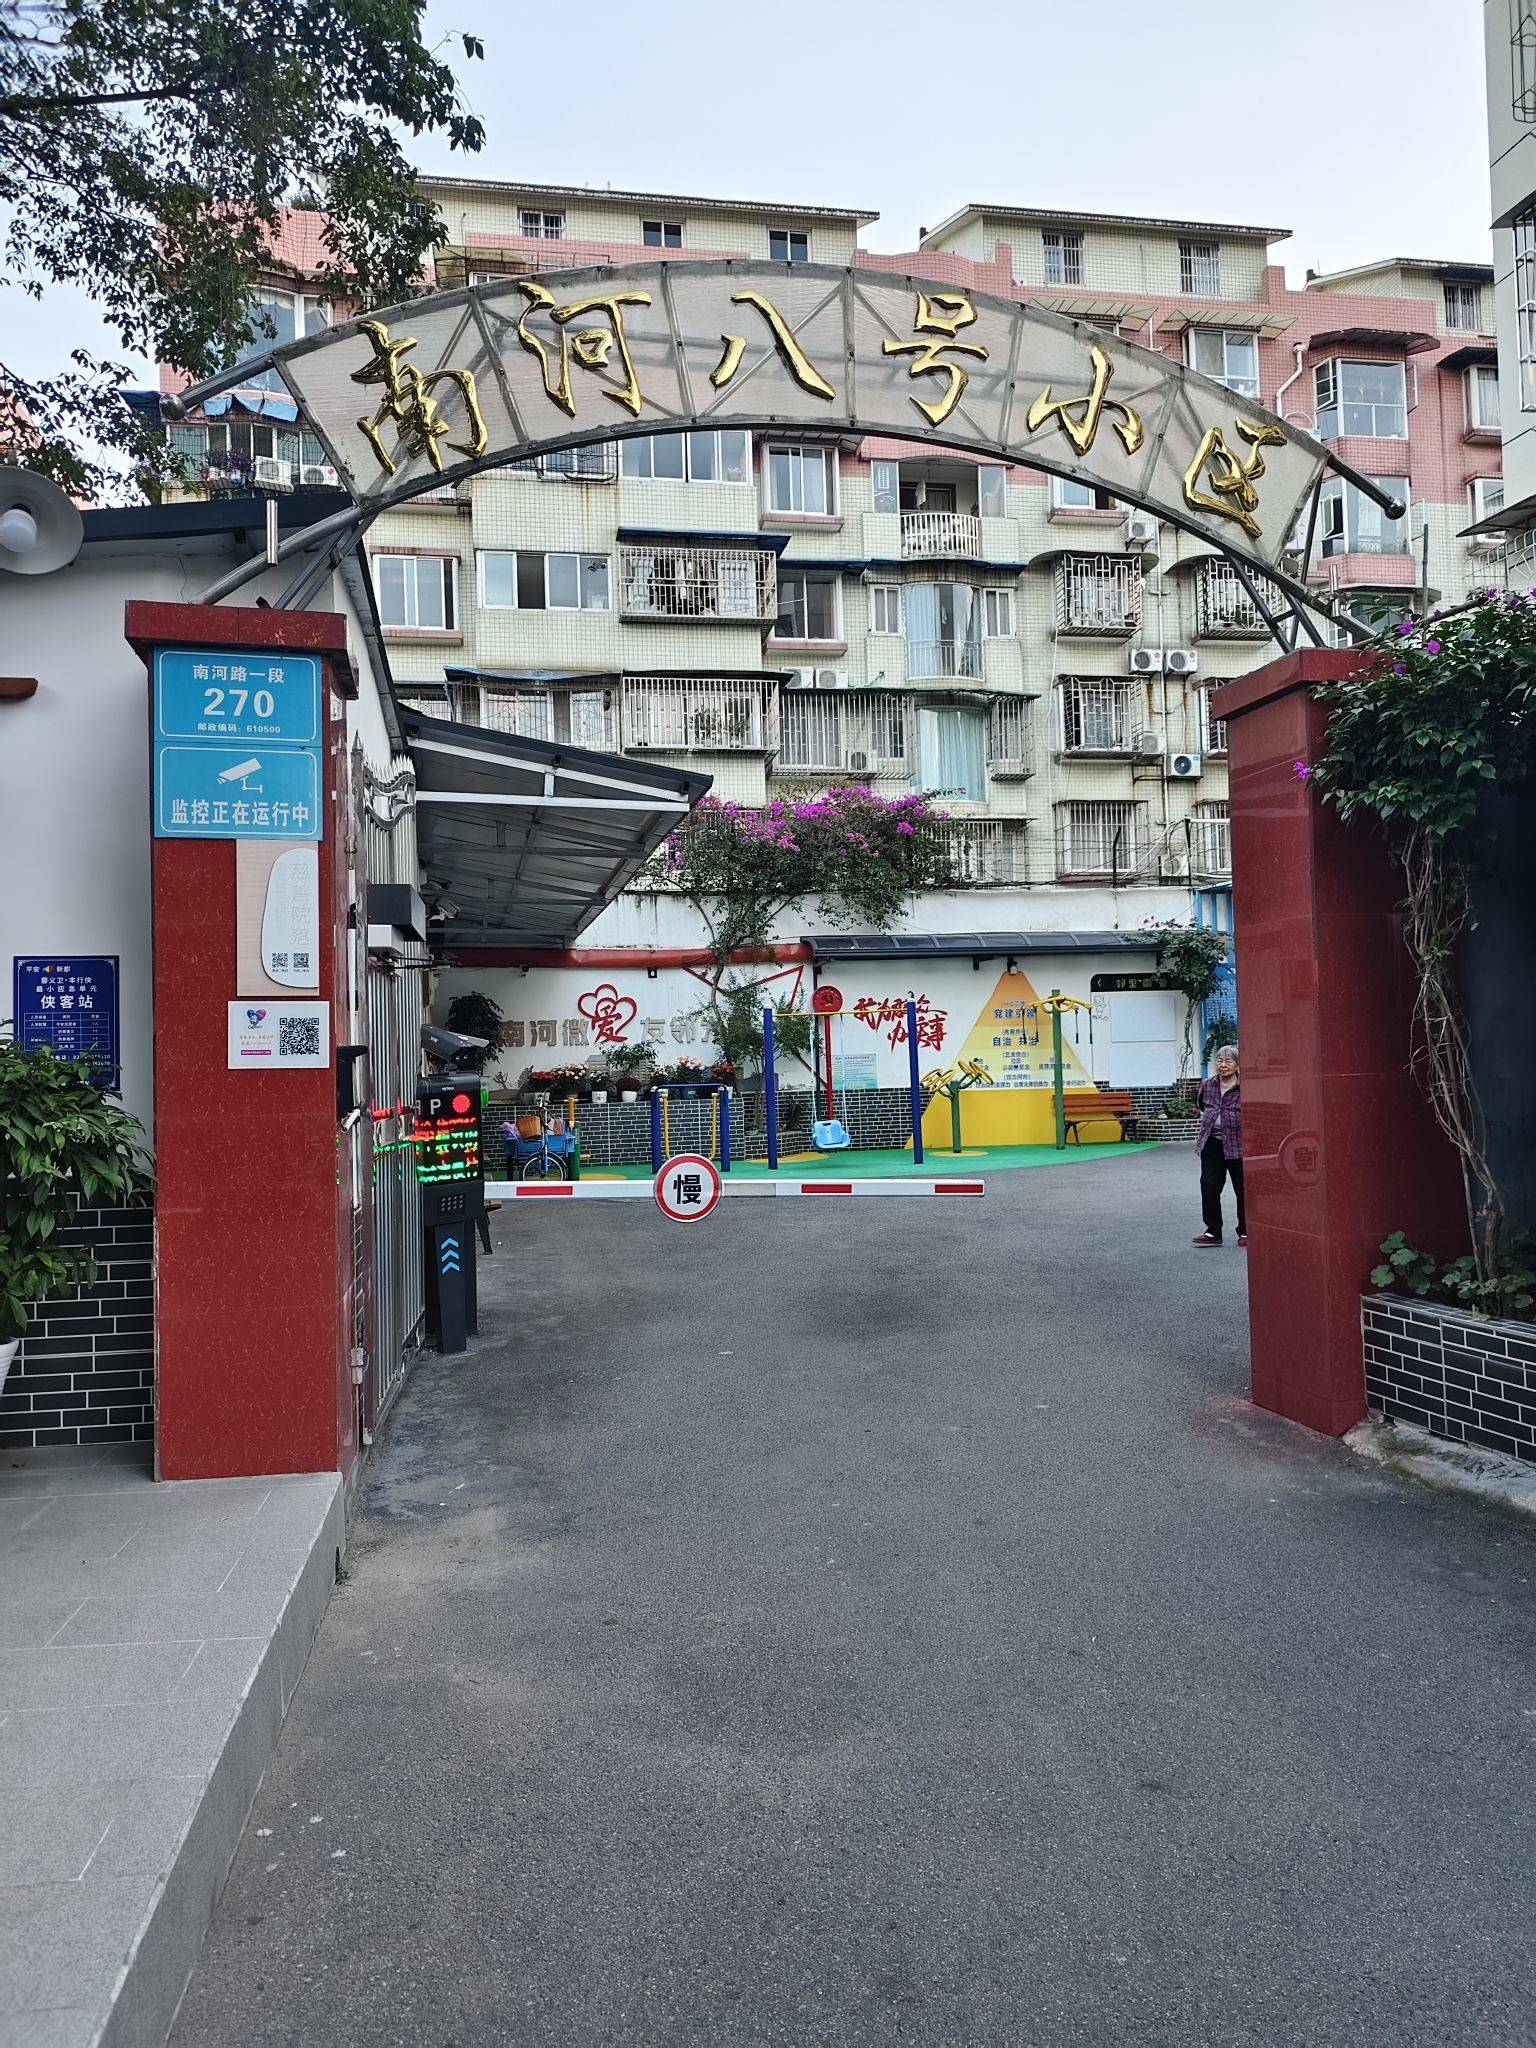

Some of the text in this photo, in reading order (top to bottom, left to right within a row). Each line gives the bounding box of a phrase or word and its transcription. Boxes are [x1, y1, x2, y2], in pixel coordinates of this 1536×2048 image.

[351, 281, 1288, 538] 南河八号小区
[192, 664, 285, 684] 南河路一段
[203, 687, 275, 718] 270
[170, 799, 310, 828] 监控正在运行中
[289, 862, 311, 946] 慈善院落
[36, 985, 98, 993] 最小应急单元
[41, 994, 93, 1010] 侠客站
[992, 1036, 1012, 1047] 自治
[430, 1098, 442, 1116] P
[672, 1173, 703, 1205] 慢
